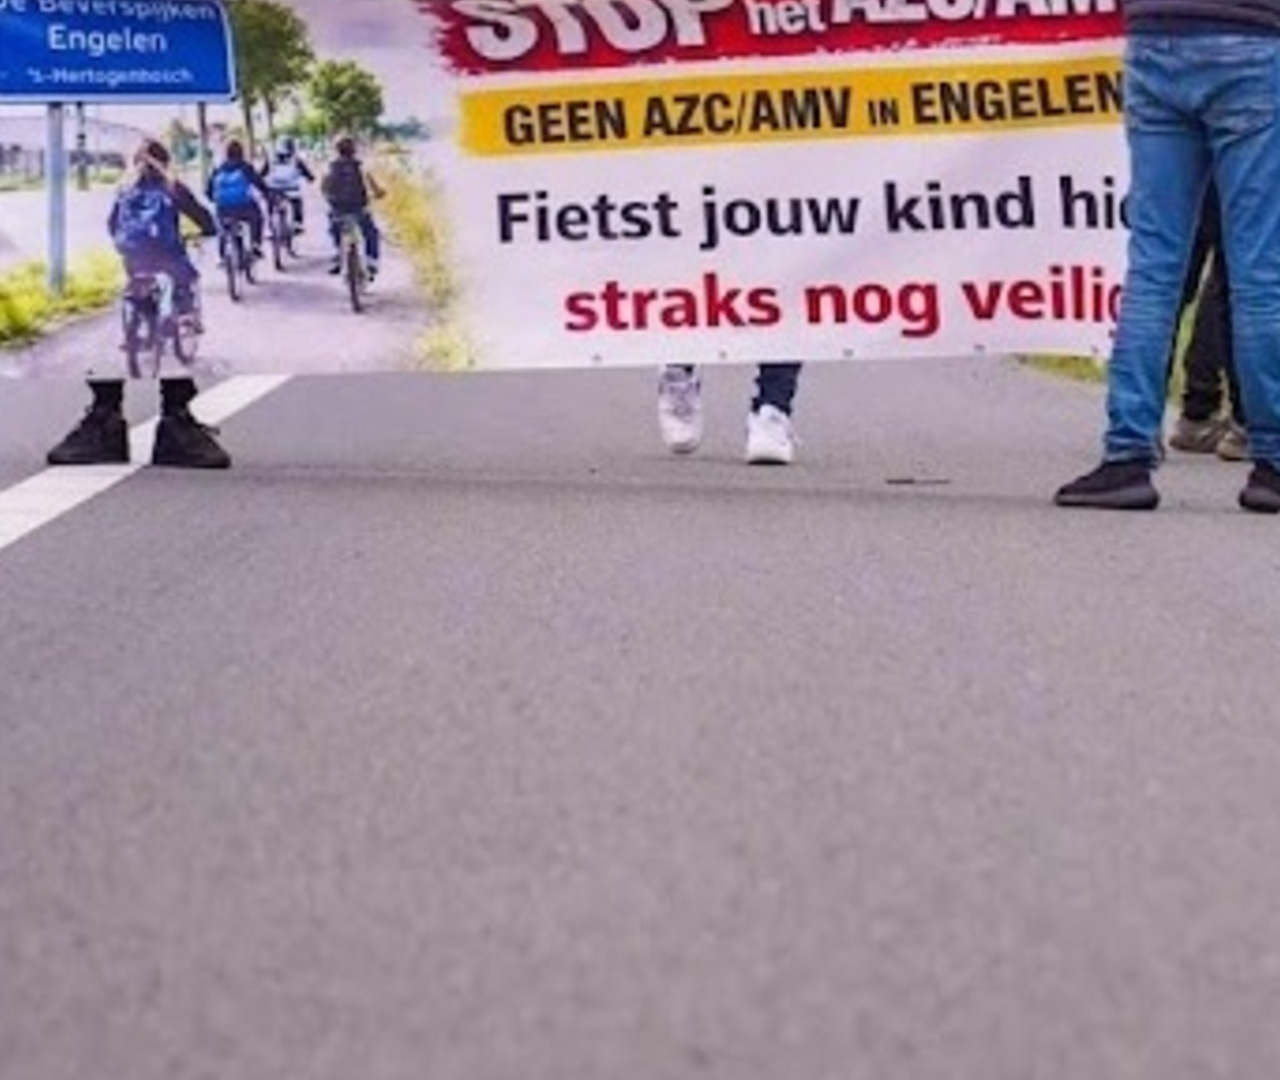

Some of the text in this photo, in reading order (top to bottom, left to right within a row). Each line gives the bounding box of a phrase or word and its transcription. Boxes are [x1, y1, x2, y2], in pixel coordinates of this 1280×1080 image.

[48, 24, 168, 56] Engelen
[504, 72, 1125, 145] GEEN AZC/AMV IN ENGELEN
[497, 190, 681, 243] Fietst
[699, 186, 859, 251] jouw
[883, 176, 1035, 232] kind
[564, 272, 782, 332] straks
[804, 282, 940, 338] nog
